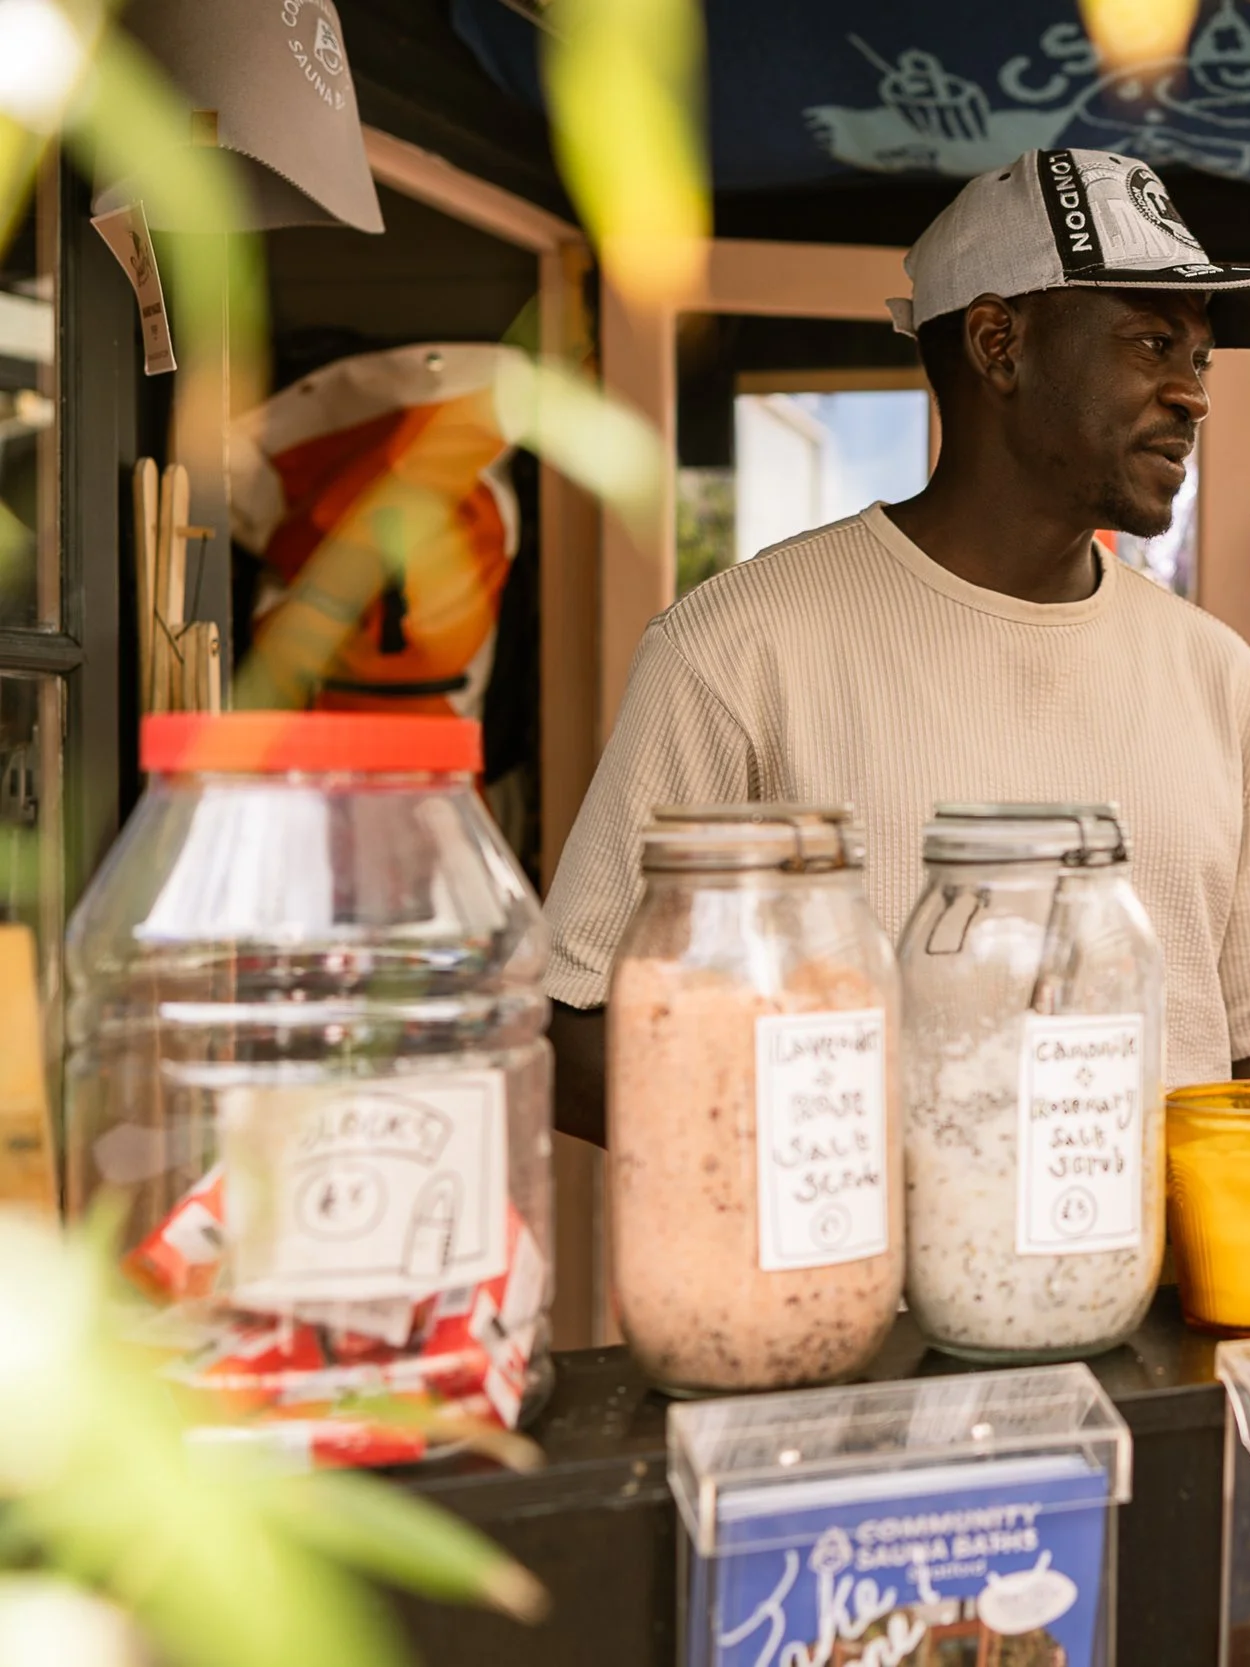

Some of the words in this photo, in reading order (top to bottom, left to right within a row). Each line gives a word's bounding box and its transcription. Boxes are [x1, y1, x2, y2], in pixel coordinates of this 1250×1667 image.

[1049, 152, 1093, 252] LONDON
[855, 1502, 1043, 1545] COMMUNITY
[952, 1526, 1040, 1561] BATHS
